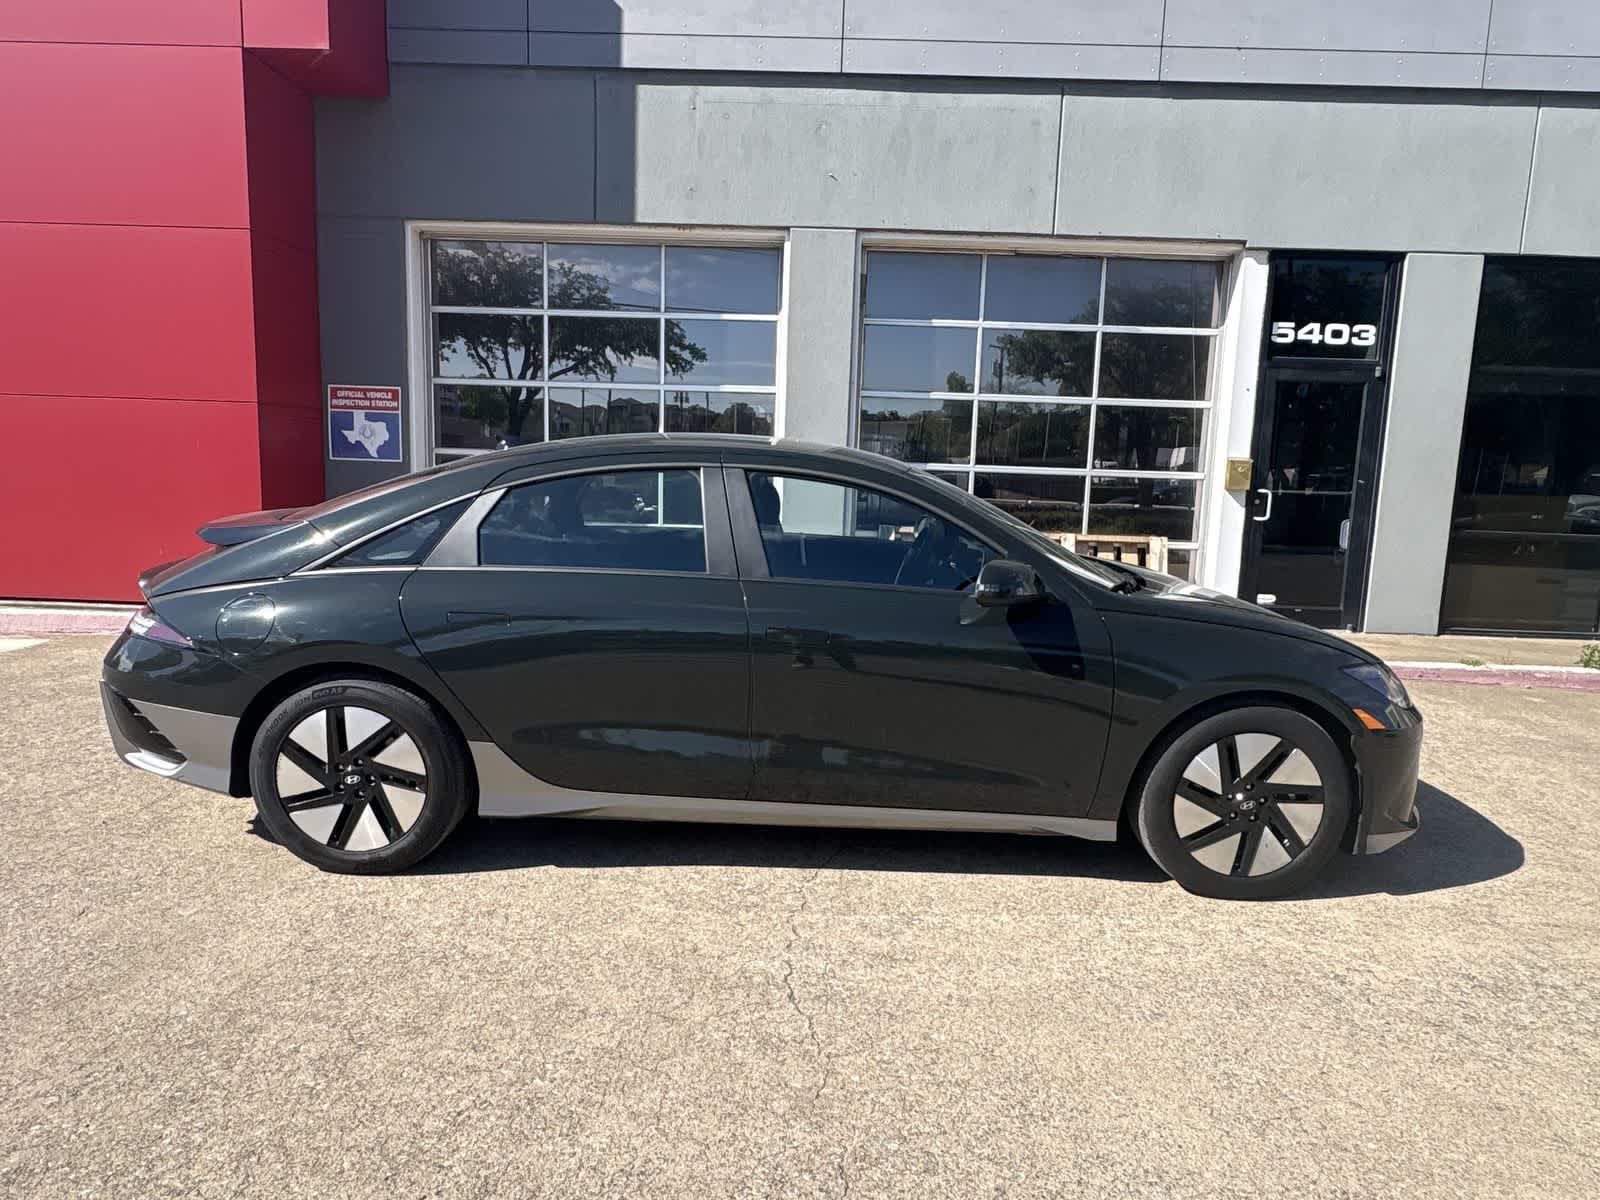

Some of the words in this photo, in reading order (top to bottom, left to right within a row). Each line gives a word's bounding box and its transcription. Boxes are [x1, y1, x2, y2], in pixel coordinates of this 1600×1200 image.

[1271, 322, 1376, 346] 5403
[367, 391, 392, 399] VEHICLE
[332, 399, 370, 407] INSPECTION
[371, 400, 398, 408] STATION
